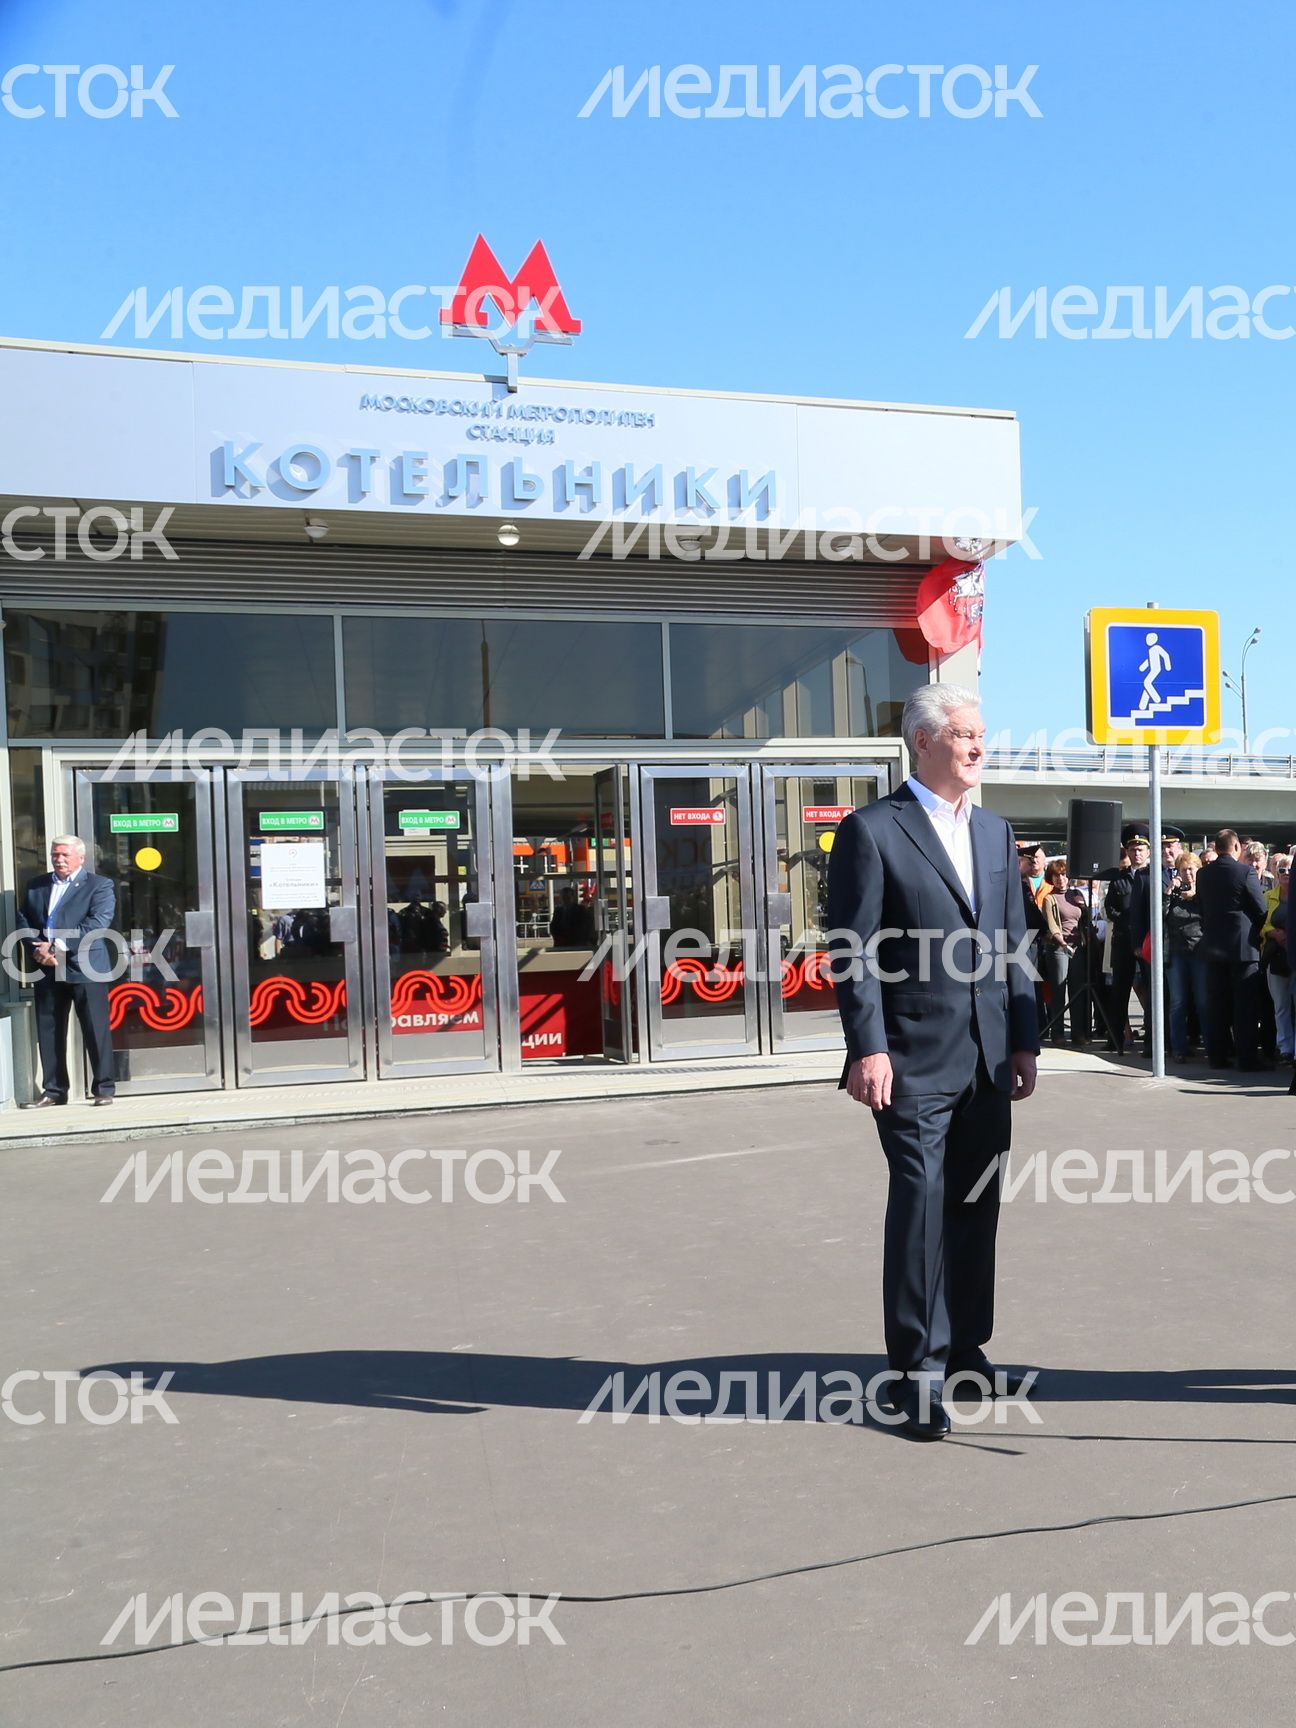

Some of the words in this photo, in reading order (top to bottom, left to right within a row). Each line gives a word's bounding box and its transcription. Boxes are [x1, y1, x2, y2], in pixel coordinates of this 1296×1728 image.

[360, 393, 502, 419] МОСКОВСКИЙ
[507, 404, 656, 428] МЕТРОПОЛИТЕН
[465, 424, 556, 446] СТАНЦИЯ
[221, 440, 778, 512] КОТЕЛЬНИКИ
[673, 812, 686, 821] НЕТ
[687, 812, 711, 820] ВХОДА
[806, 810, 818, 818] НЕТ
[819, 810, 841, 818] ВХОДА
[113, 819, 132, 828] ВХОД
[138, 818, 161, 827] МЕТРО
[262, 817, 280, 826] ВХОД
[286, 817, 307, 825] МЕТРО
[401, 816, 418, 825] ВХОД
[424, 816, 444, 824] МЕТРО
